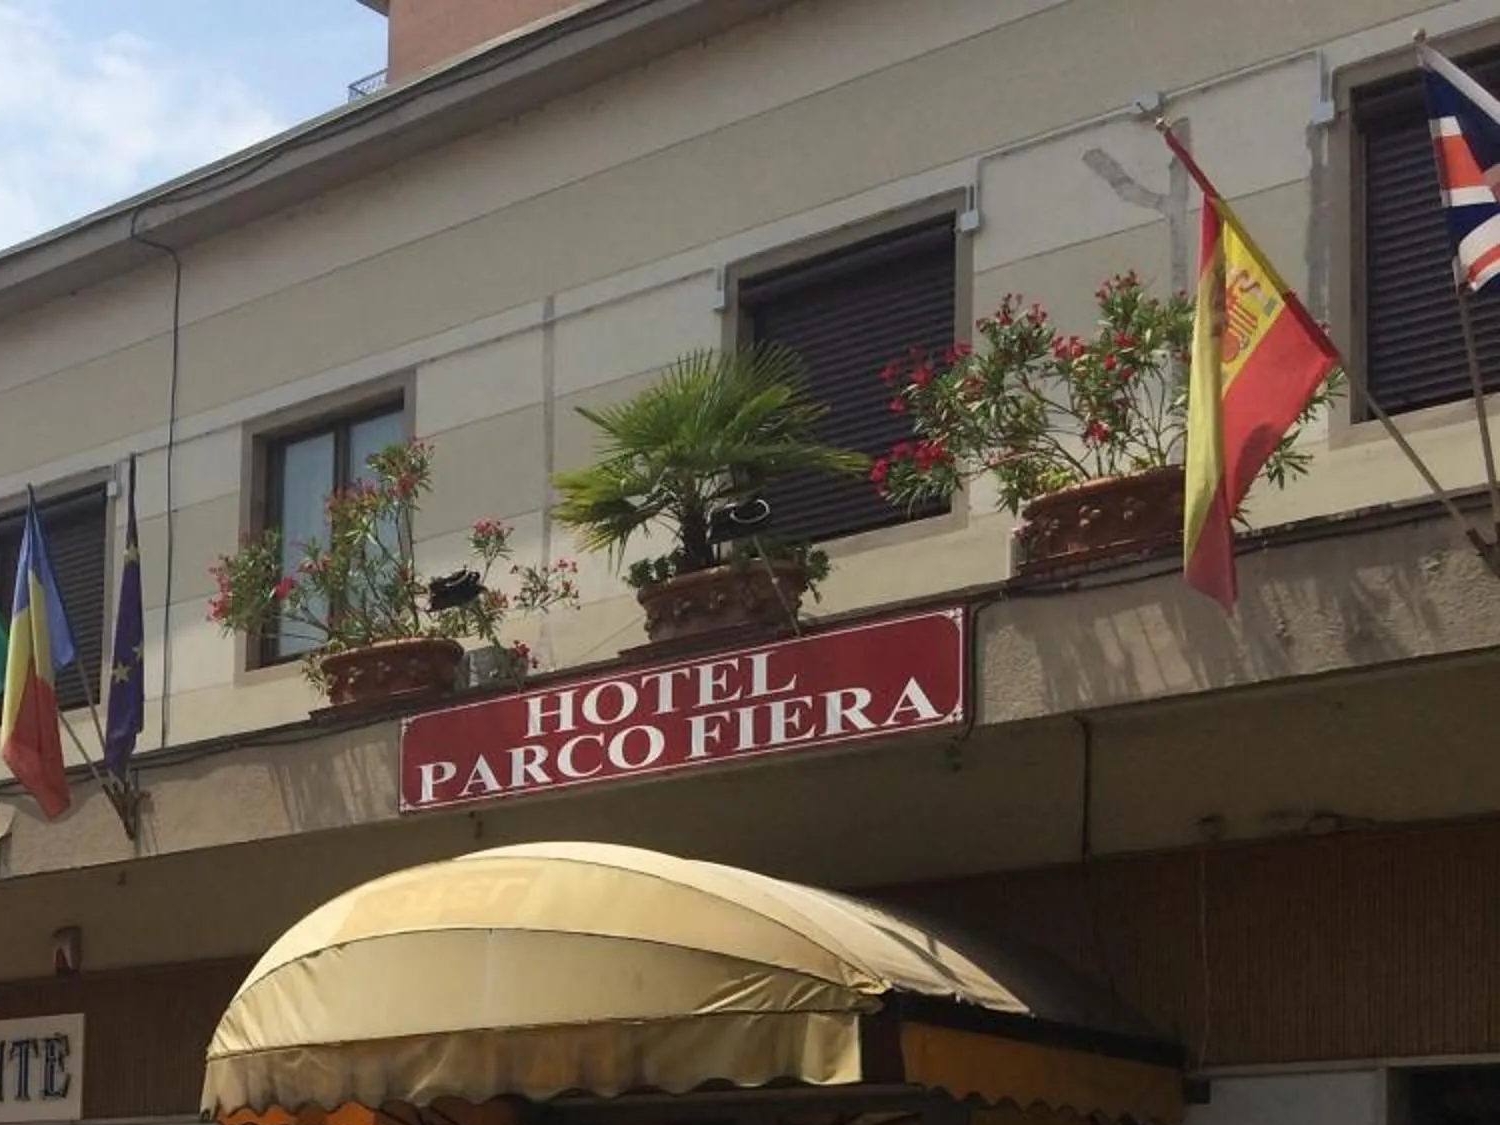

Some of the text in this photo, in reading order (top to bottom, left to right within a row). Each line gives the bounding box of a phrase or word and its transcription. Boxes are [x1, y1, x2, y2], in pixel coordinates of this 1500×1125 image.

[418, 678, 943, 802] PARCO FIERA
[526, 651, 797, 738] HOTEL
